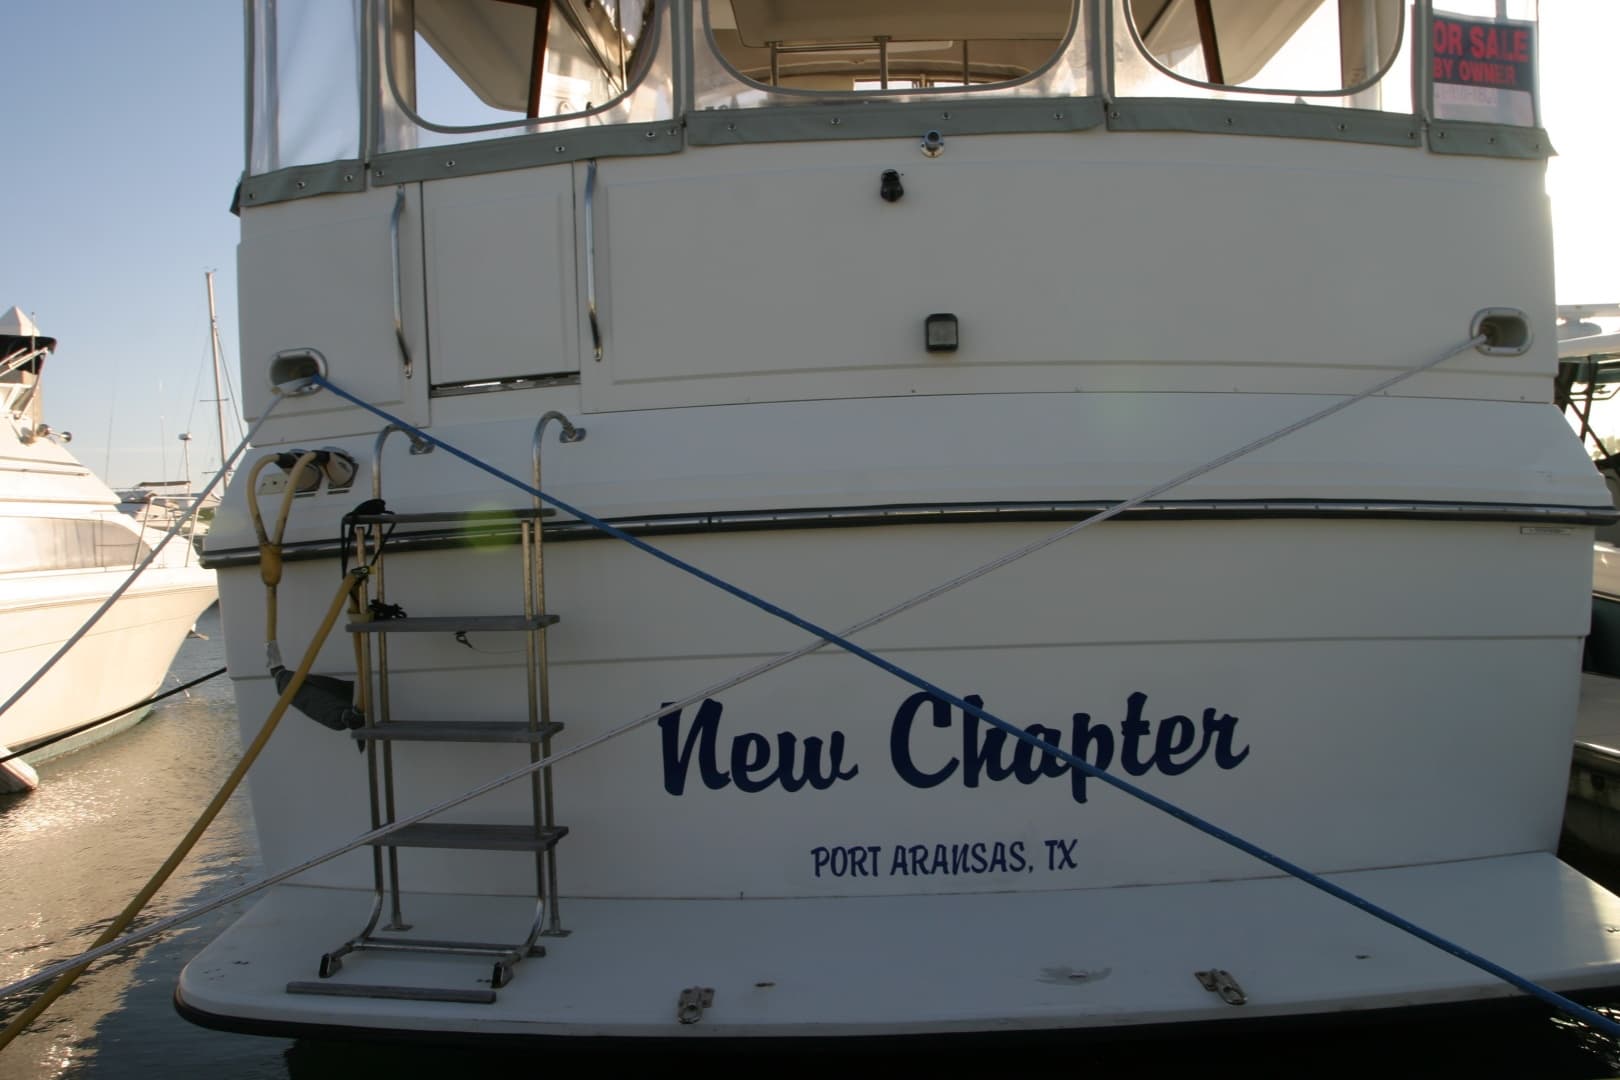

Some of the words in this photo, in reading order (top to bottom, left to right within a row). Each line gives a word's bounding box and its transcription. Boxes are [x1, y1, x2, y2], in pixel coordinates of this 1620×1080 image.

[1432, 20, 1463, 57] OR
[1469, 25, 1529, 63] SALE
[1432, 57, 1453, 79] BY
[1458, 60, 1517, 85] OWNER
[658, 698, 858, 796] New
[890, 691, 1250, 803] Chapter
[811, 845, 881, 878] PORT
[889, 840, 1034, 876] ARANSAS,
[1045, 838, 1078, 871] TX
